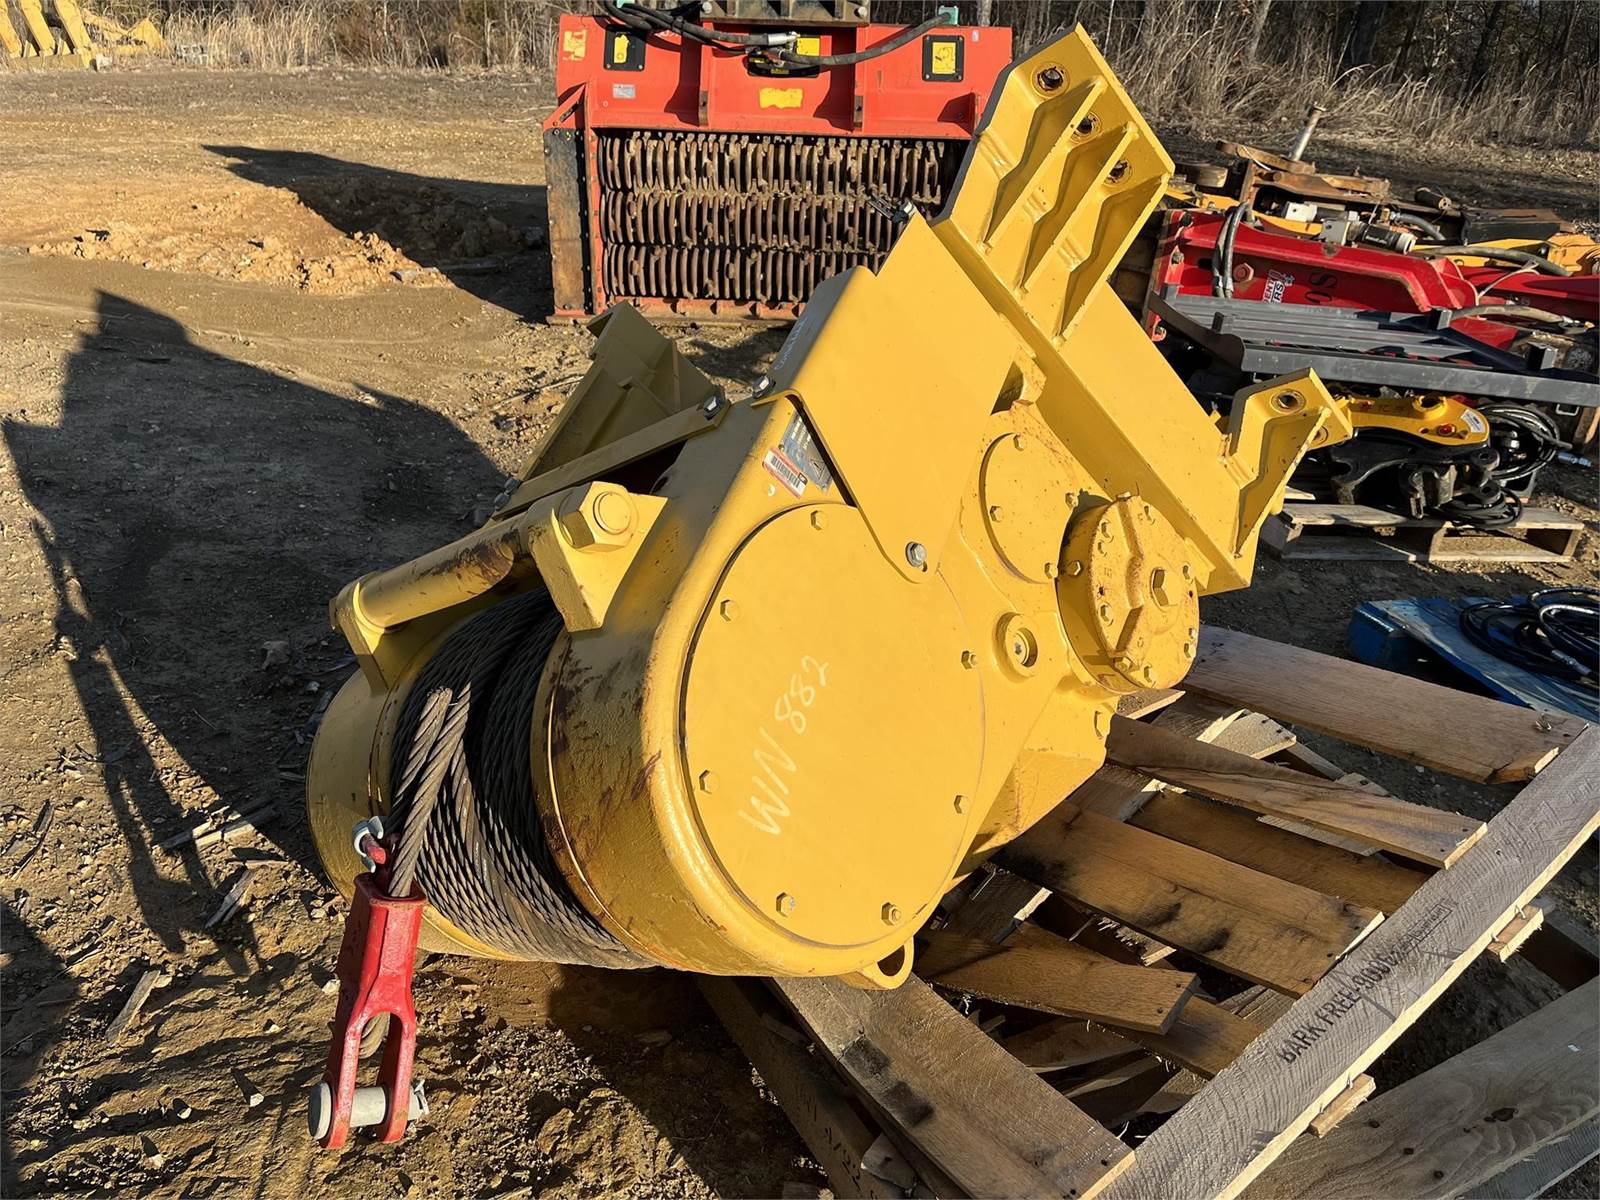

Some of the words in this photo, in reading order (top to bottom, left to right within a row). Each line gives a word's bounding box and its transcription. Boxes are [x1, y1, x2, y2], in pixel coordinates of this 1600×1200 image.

[737, 726, 797, 834] WN
[774, 655, 829, 734] 882
[1278, 1021, 1326, 1064] BARK
